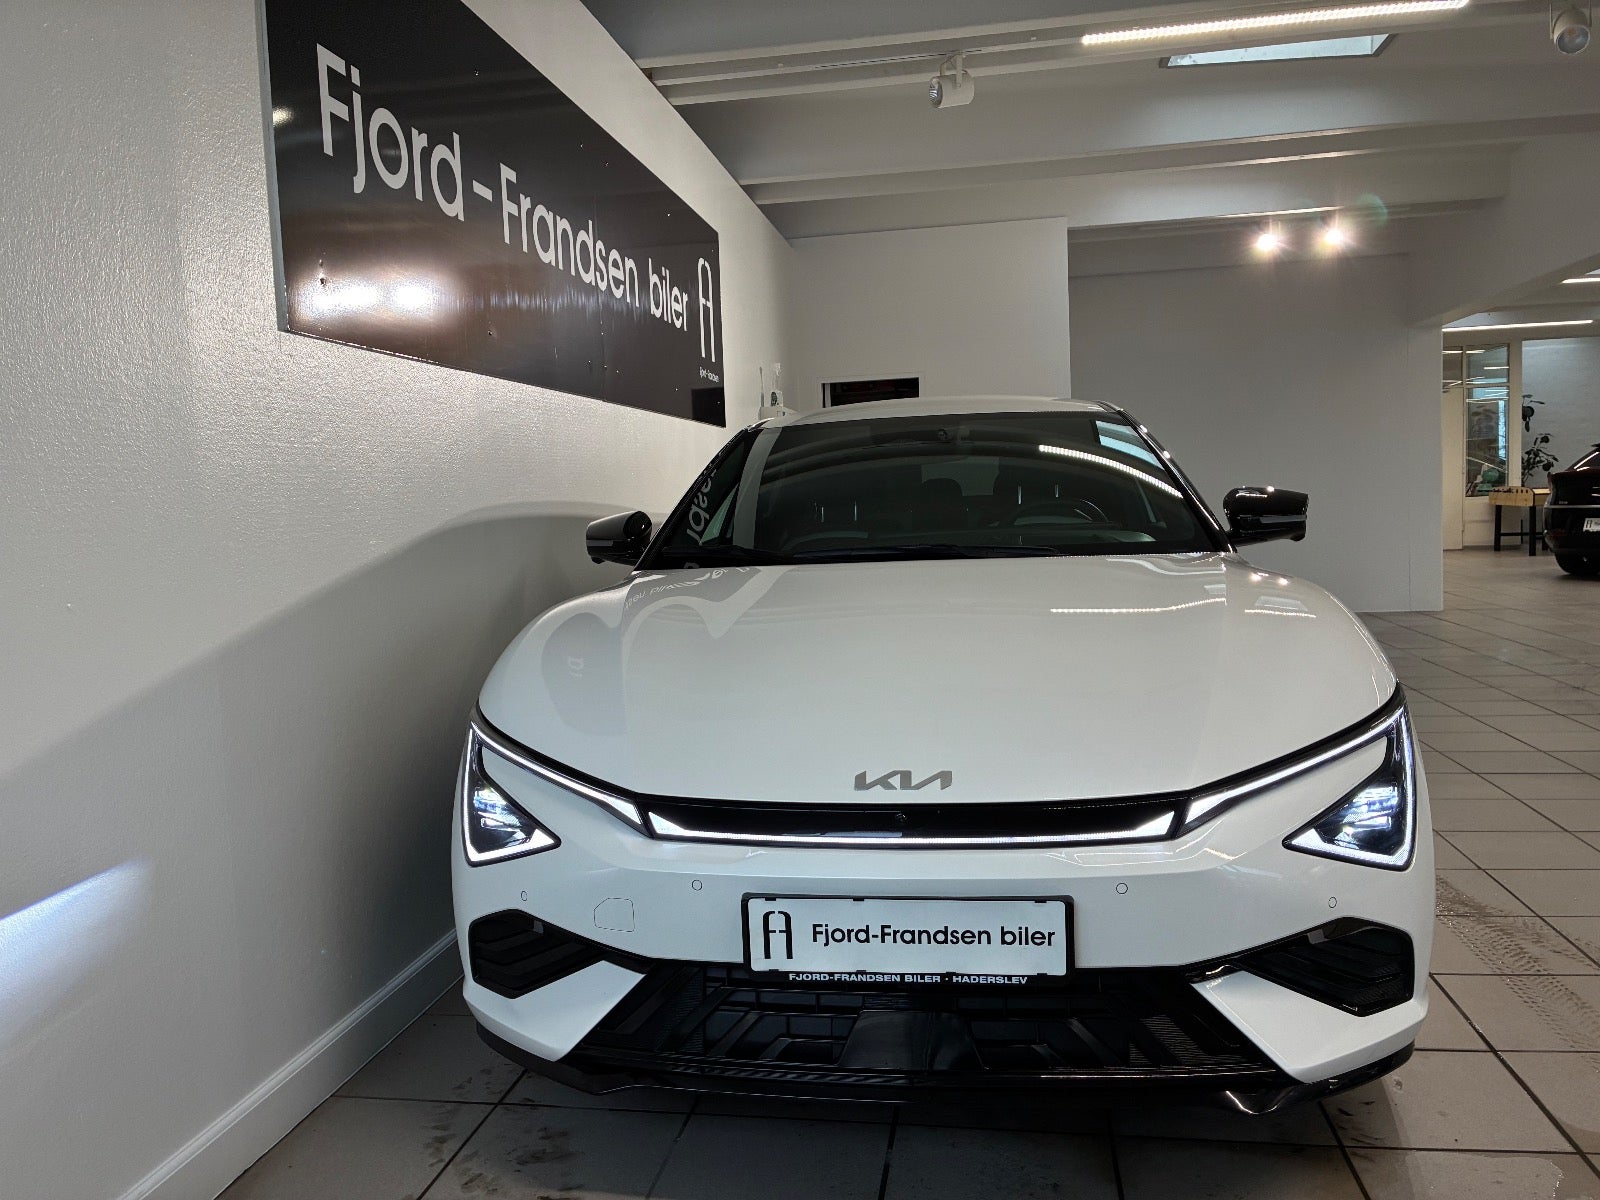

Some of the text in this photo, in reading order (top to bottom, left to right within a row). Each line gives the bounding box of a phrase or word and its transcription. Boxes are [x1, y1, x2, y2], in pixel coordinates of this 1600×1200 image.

[648, 257, 688, 332] biler
[853, 769, 953, 791] KIA
[811, 922, 1056, 947] Fjord-Frandsen biler
[788, 972, 1028, 985] FJORD-FRANDSEN BILER HADERSLEV
